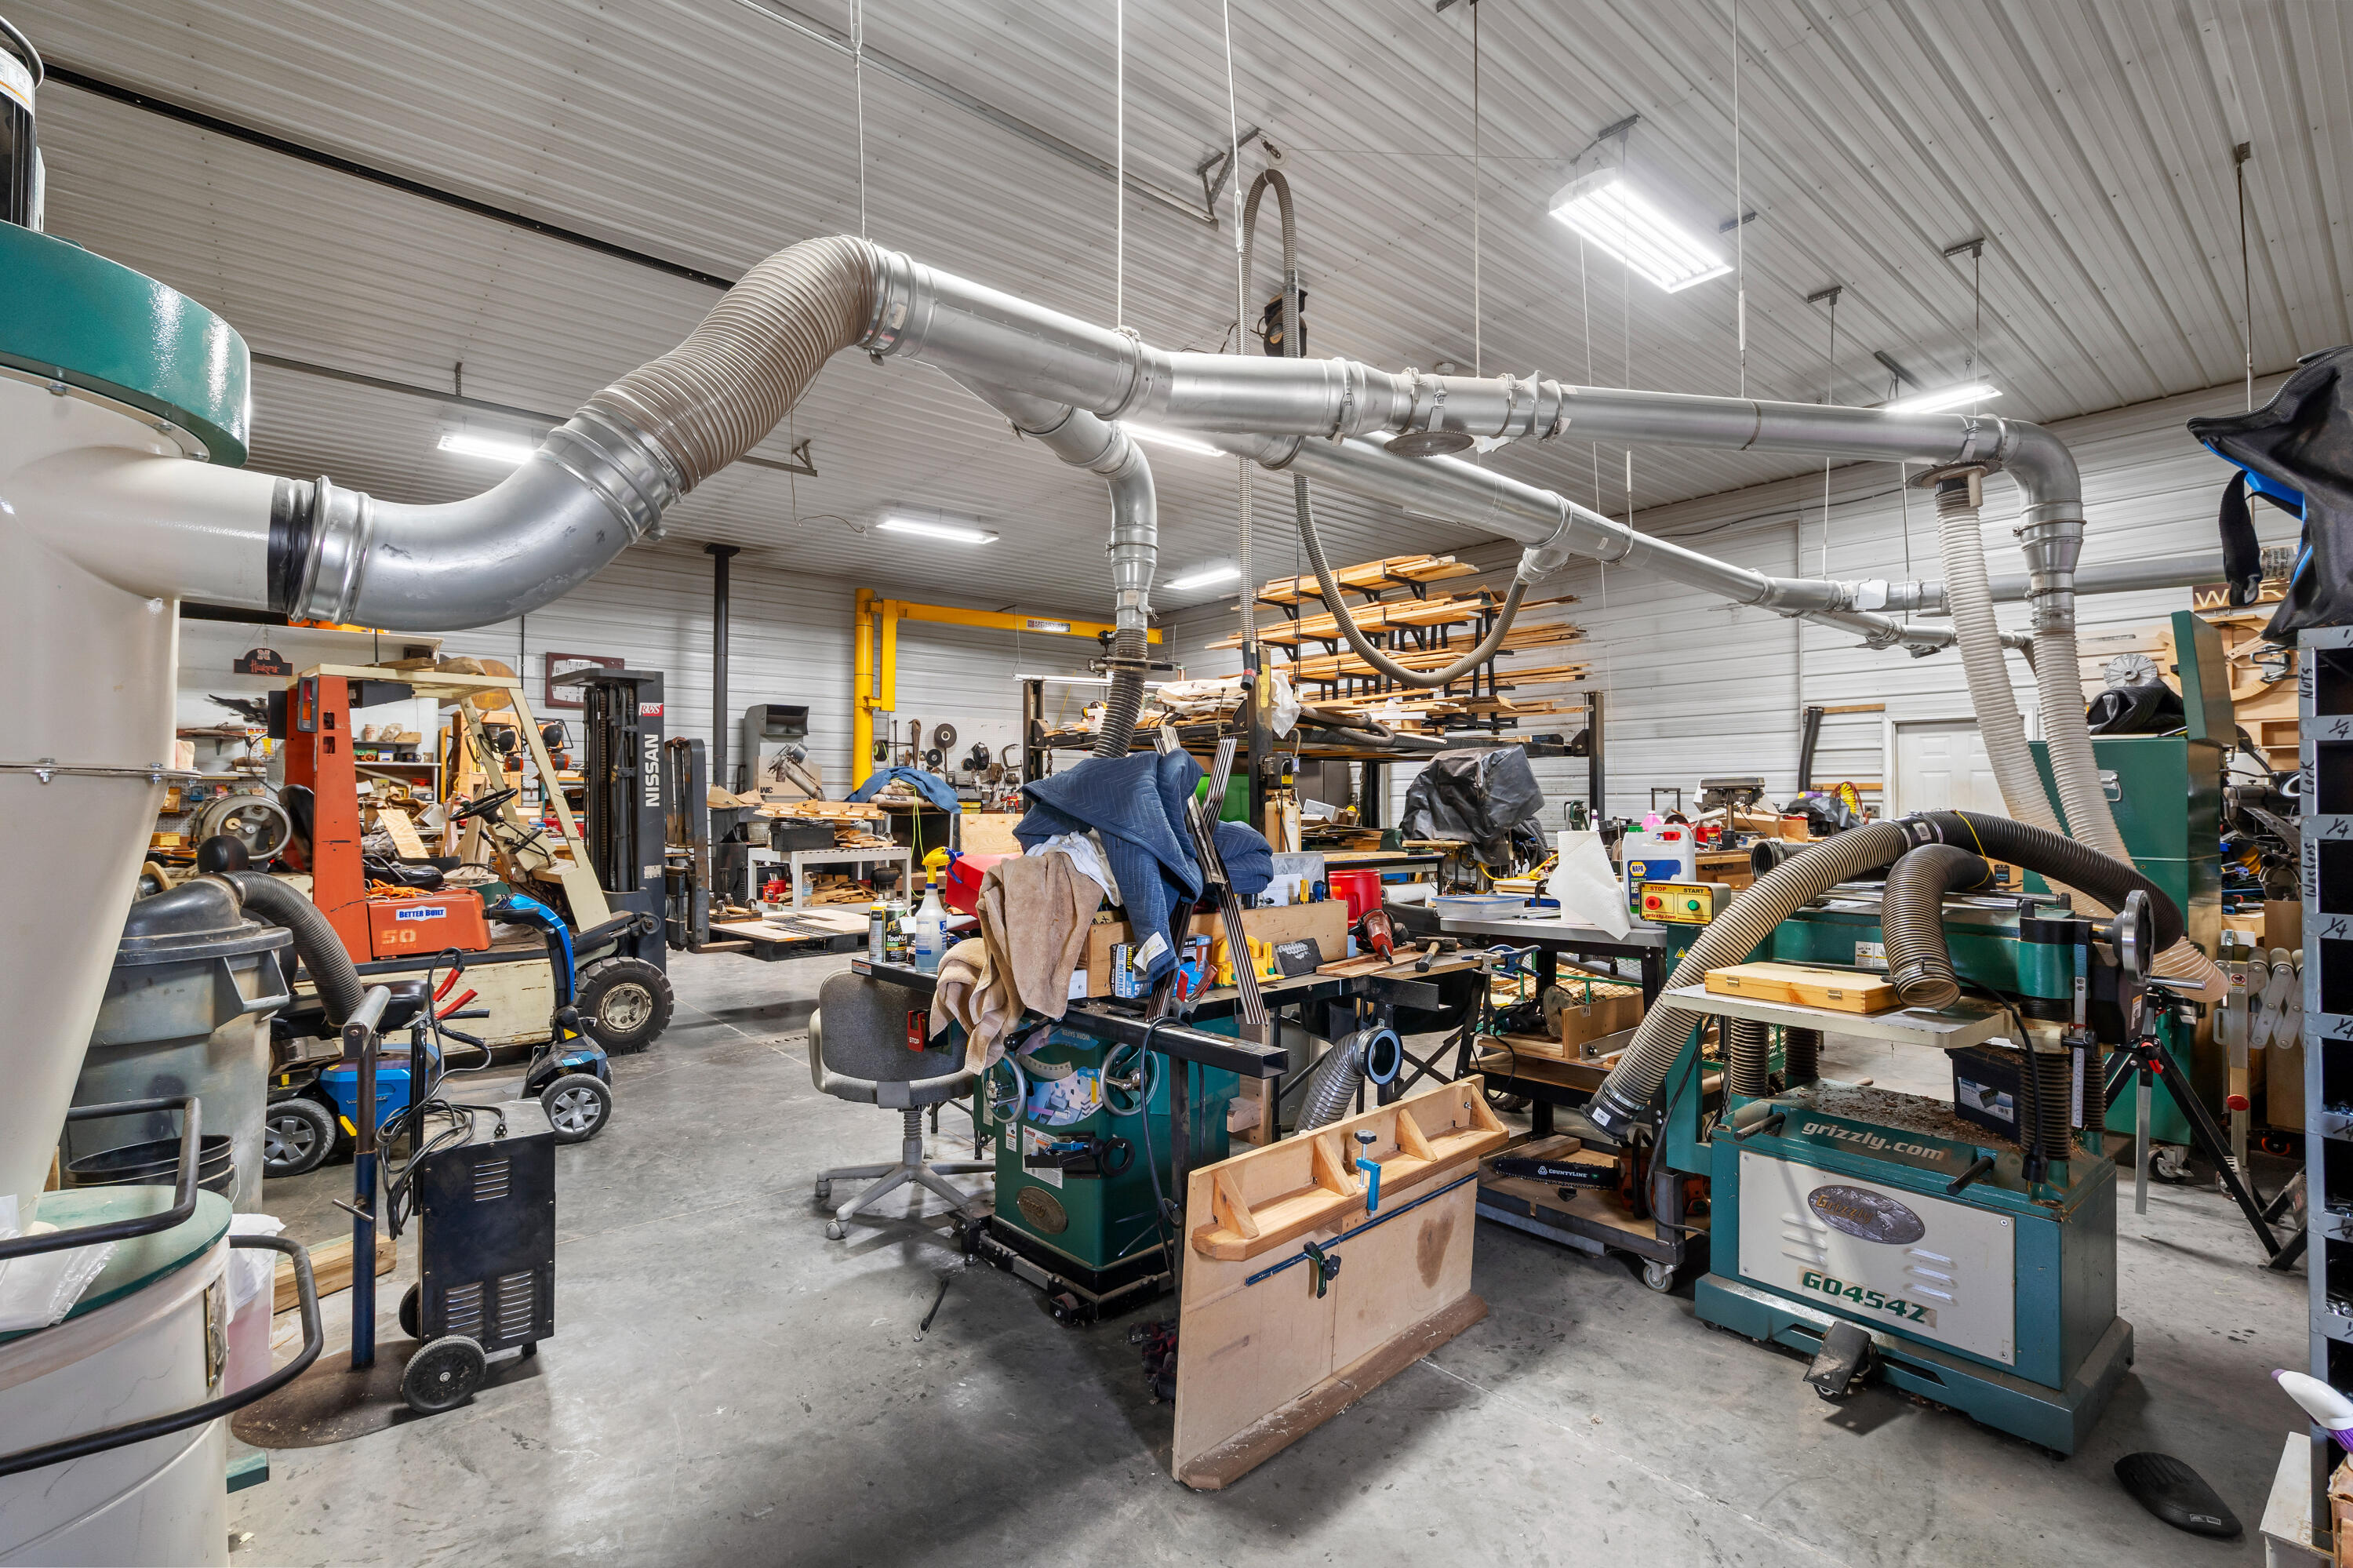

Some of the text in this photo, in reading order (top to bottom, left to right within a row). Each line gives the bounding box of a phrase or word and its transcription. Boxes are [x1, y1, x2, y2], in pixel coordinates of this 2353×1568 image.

[2195, 584, 2289, 608] WR
[644, 733, 660, 807] NISSAN
[399, 910, 424, 919] BETTER
[382, 929, 416, 944] 50
[909, 1036, 920, 1045] STOP
[1802, 1122, 1945, 1161] grizzly.com
[1816, 1194, 1875, 1224] Grizzly
